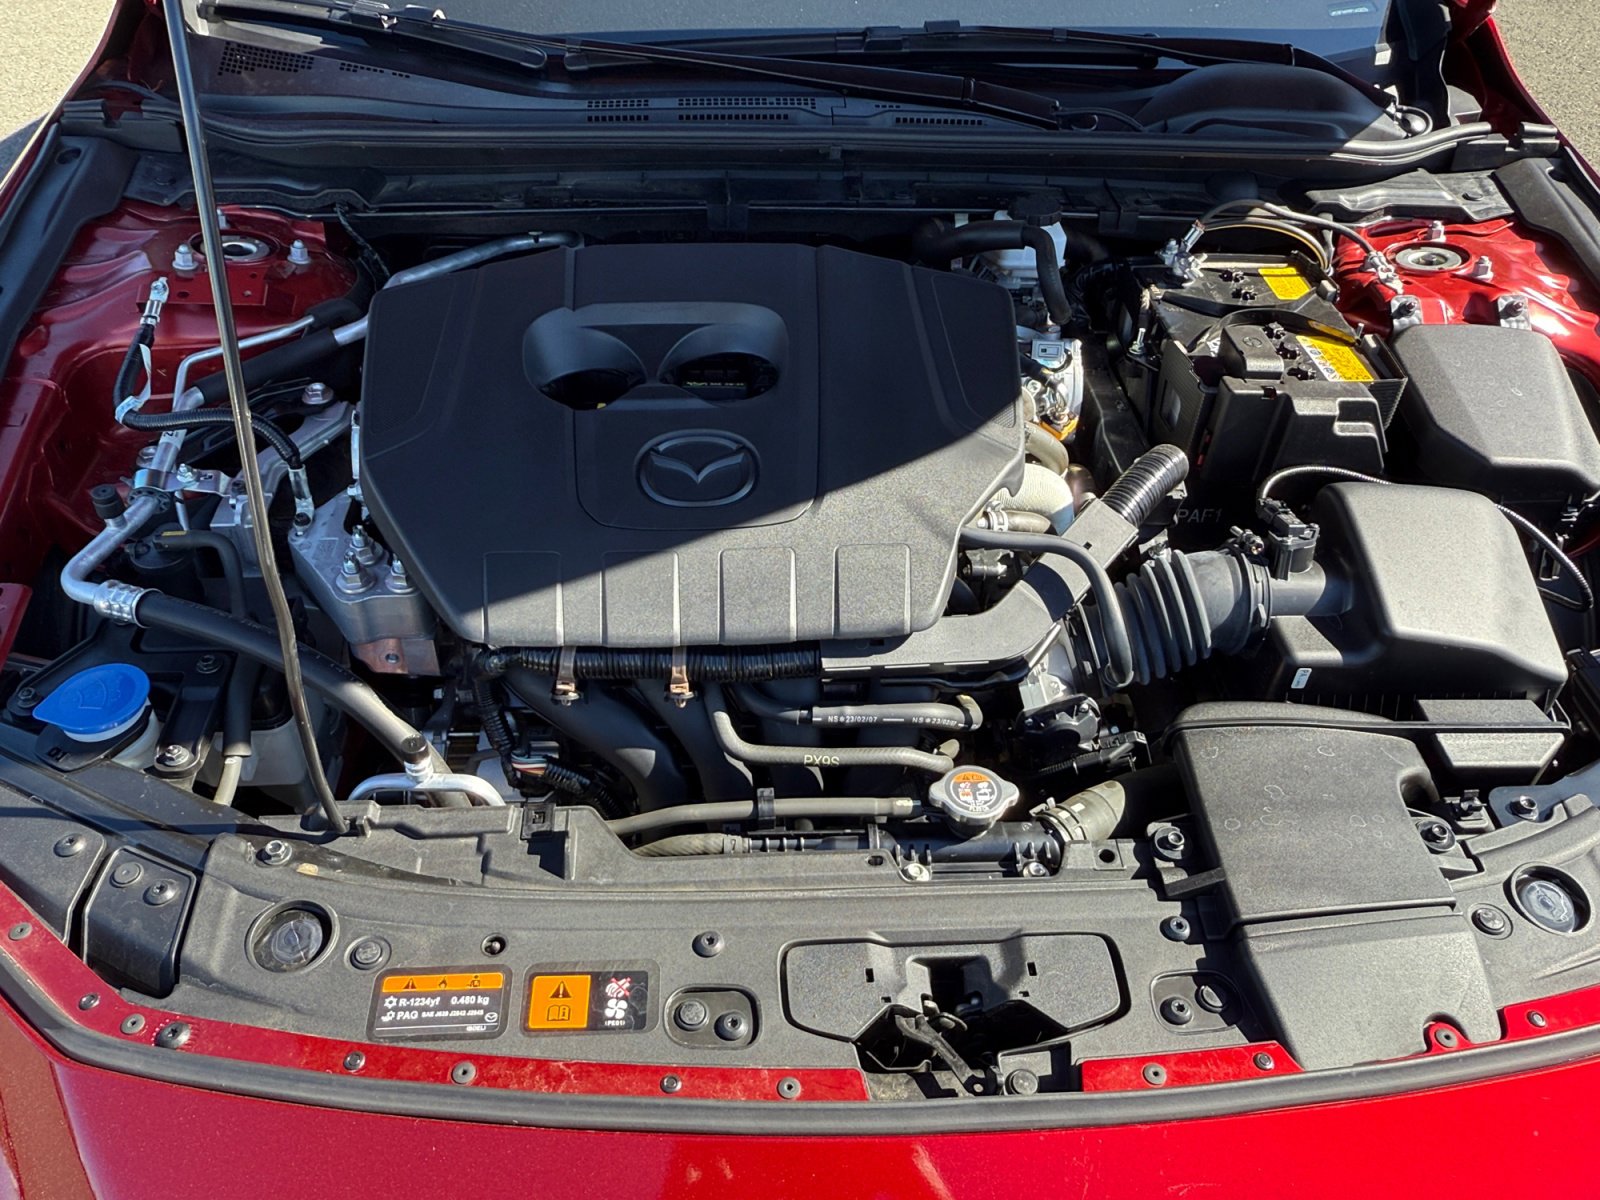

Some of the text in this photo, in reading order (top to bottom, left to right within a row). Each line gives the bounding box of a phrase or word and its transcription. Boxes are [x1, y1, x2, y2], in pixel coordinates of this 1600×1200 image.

[398, 995, 490, 1008] R-1234yf 0.480 kg
[396, 1010, 419, 1021] PAG
